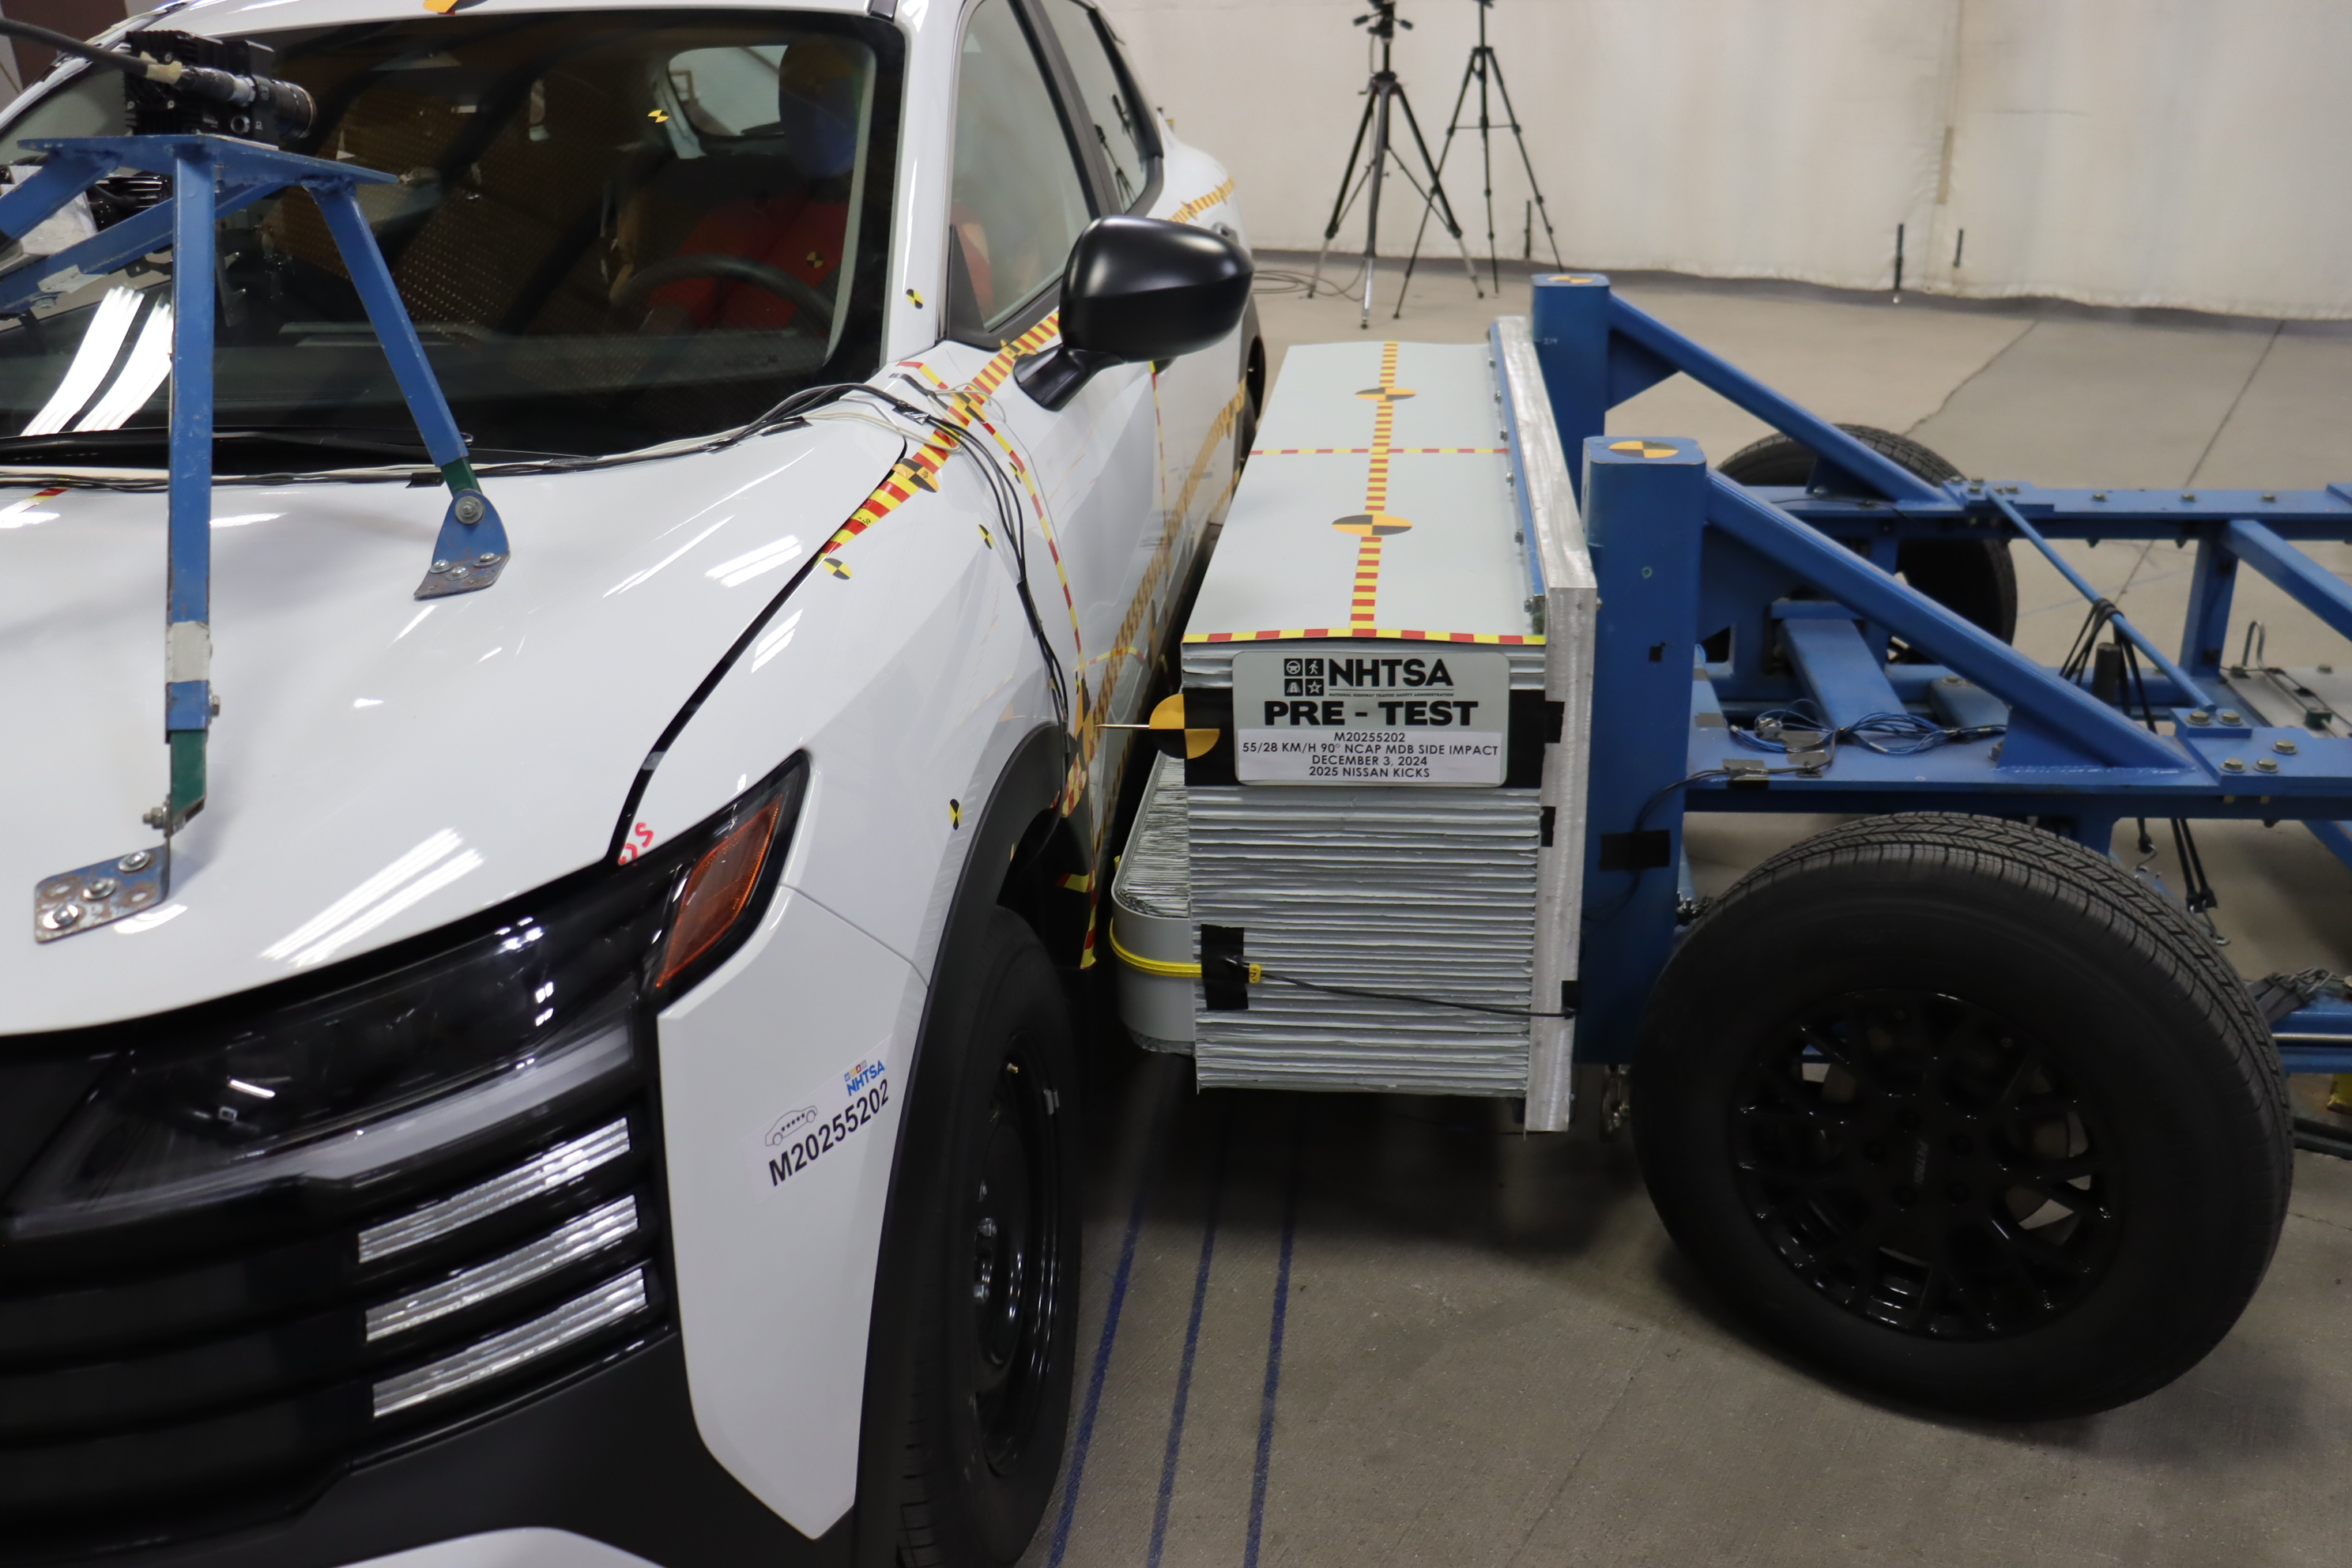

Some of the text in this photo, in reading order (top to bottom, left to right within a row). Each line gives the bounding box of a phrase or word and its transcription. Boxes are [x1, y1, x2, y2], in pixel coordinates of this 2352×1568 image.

[1329, 658, 1454, 687] NHTSA
[1265, 700, 1345, 726] PRE
[1378, 700, 1479, 726] TEST
[1334, 732, 1405, 742] M20255202
[1242, 742, 1498, 756] 55/28 KM/H 90° NCAP MDB SIDE IMPACT
[1312, 755, 1427, 767] DECEMBER 3, 2024
[1309, 767, 1430, 778] 2025 NISSAN KICKS
[846, 1060, 885, 1096] NHTSA
[768, 1079, 889, 1187] M20255202
